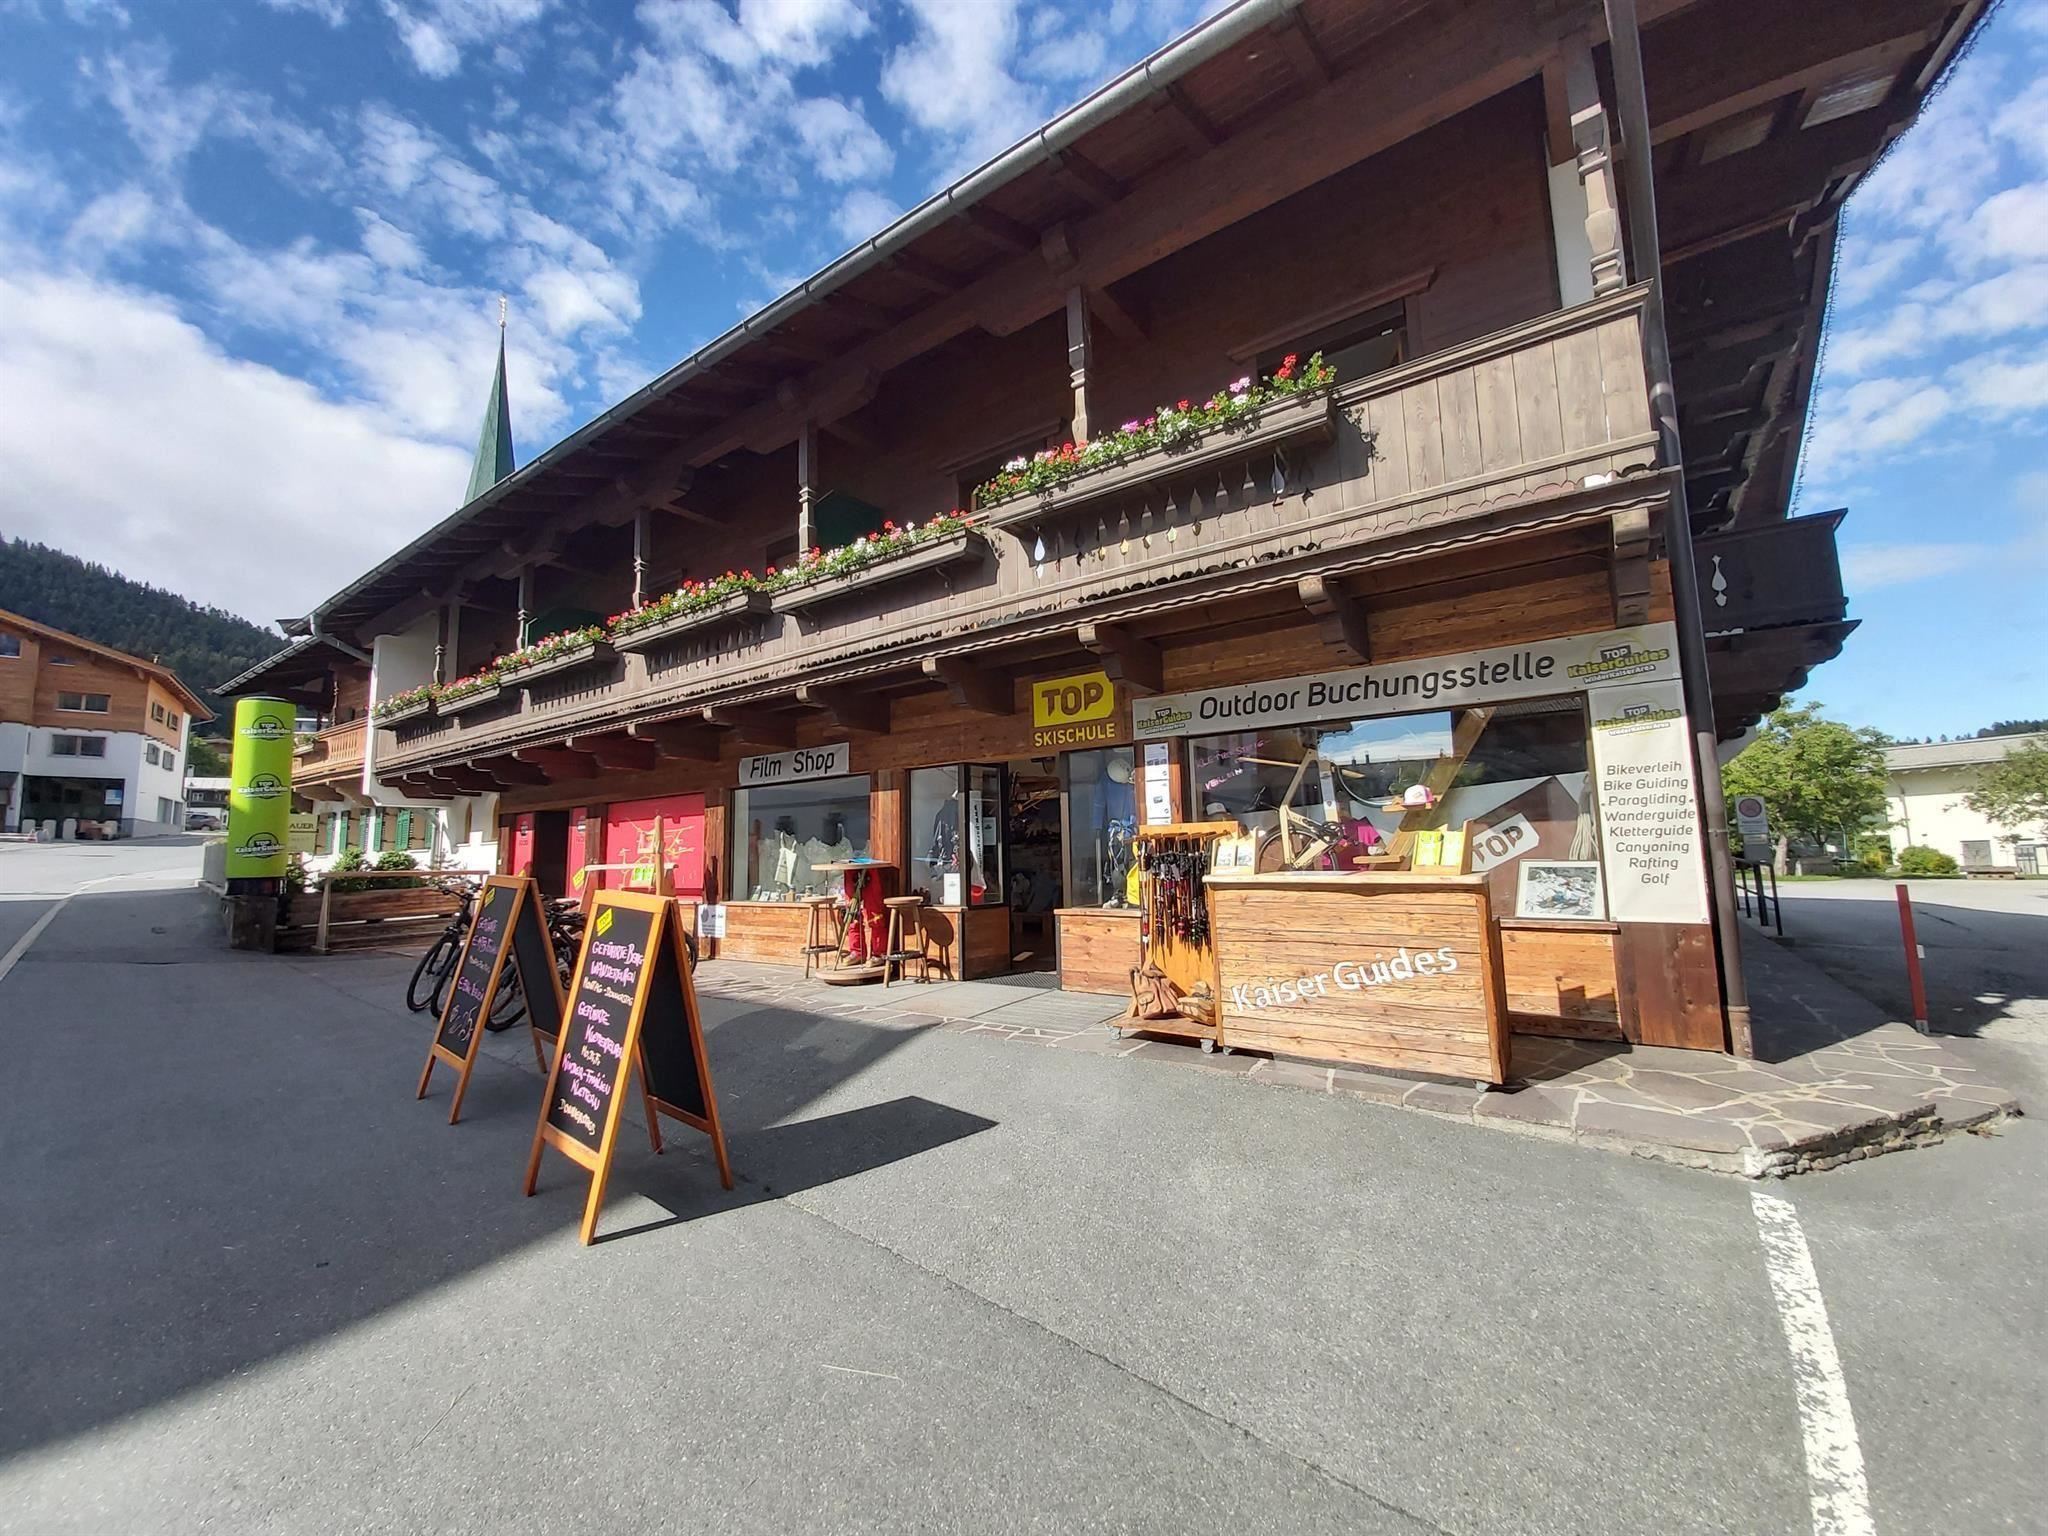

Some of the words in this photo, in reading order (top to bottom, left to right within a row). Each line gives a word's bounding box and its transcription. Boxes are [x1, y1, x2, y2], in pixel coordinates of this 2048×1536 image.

[1603, 647, 1628, 660] TOP
[1567, 647, 1670, 678] KaiserGuides
[1199, 690, 1300, 720] Outdoor
[1307, 652, 1555, 707] Buchungsstelle
[1041, 682, 1104, 718] TOP
[1626, 706, 1648, 717] TOP
[1033, 723, 1115, 748] SKISCHULE
[749, 756, 782, 780] Film
[792, 749, 835, 775] Shop
[1606, 761, 1682, 776] Bikeverleih
[1603, 780, 1633, 791] Bike
[1636, 778, 1689, 790] Guiding
[1608, 793, 1687, 807] Paragliding
[1604, 808, 1696, 822] Wanderguide
[1609, 825, 1693, 838] Kletterguide
[1472, 824, 1524, 863] TOP
[1615, 841, 1690, 854] Canyoning
[1629, 857, 1679, 870] Rafting
[1641, 873, 1670, 885] Golf
